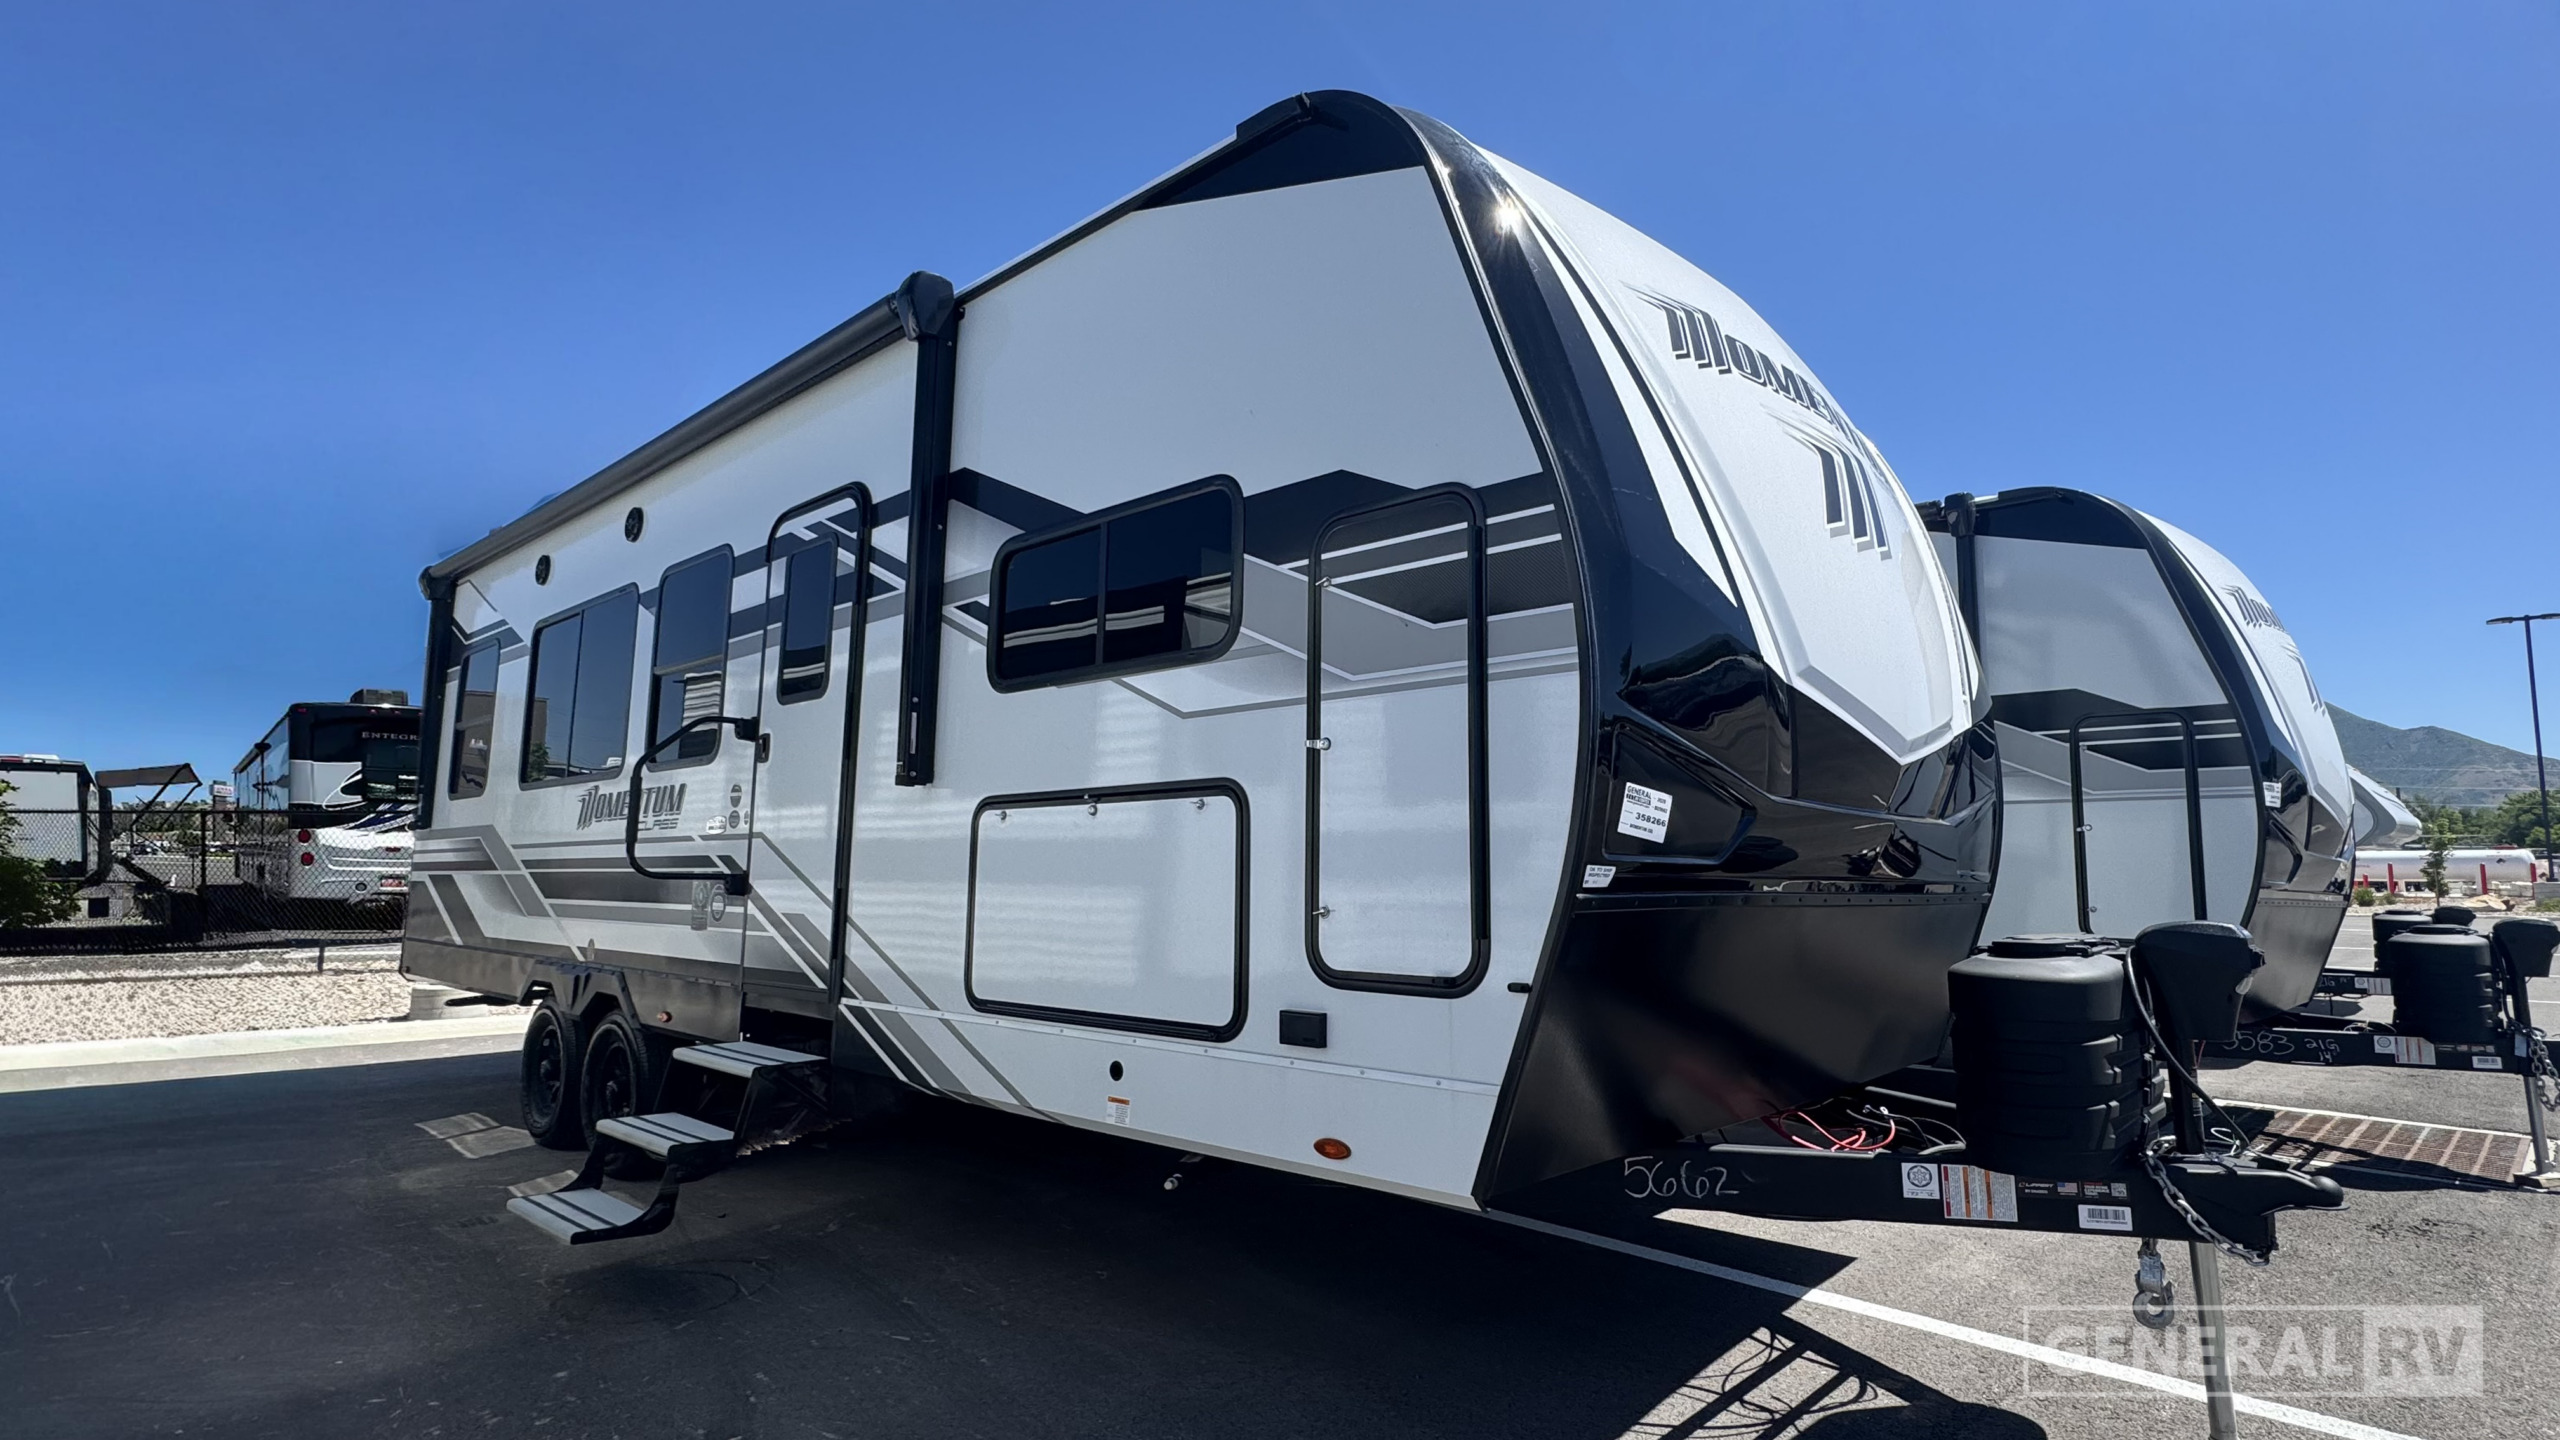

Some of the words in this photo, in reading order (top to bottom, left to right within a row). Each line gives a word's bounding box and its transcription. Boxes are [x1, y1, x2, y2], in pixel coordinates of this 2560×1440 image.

[361, 731, 420, 740] ENTEGR
[1627, 785, 1652, 800] GENERAL
[576, 783, 687, 831] MOMETUM
[1635, 812, 1667, 828] 358266
[1624, 1155, 1740, 1199] 5662
